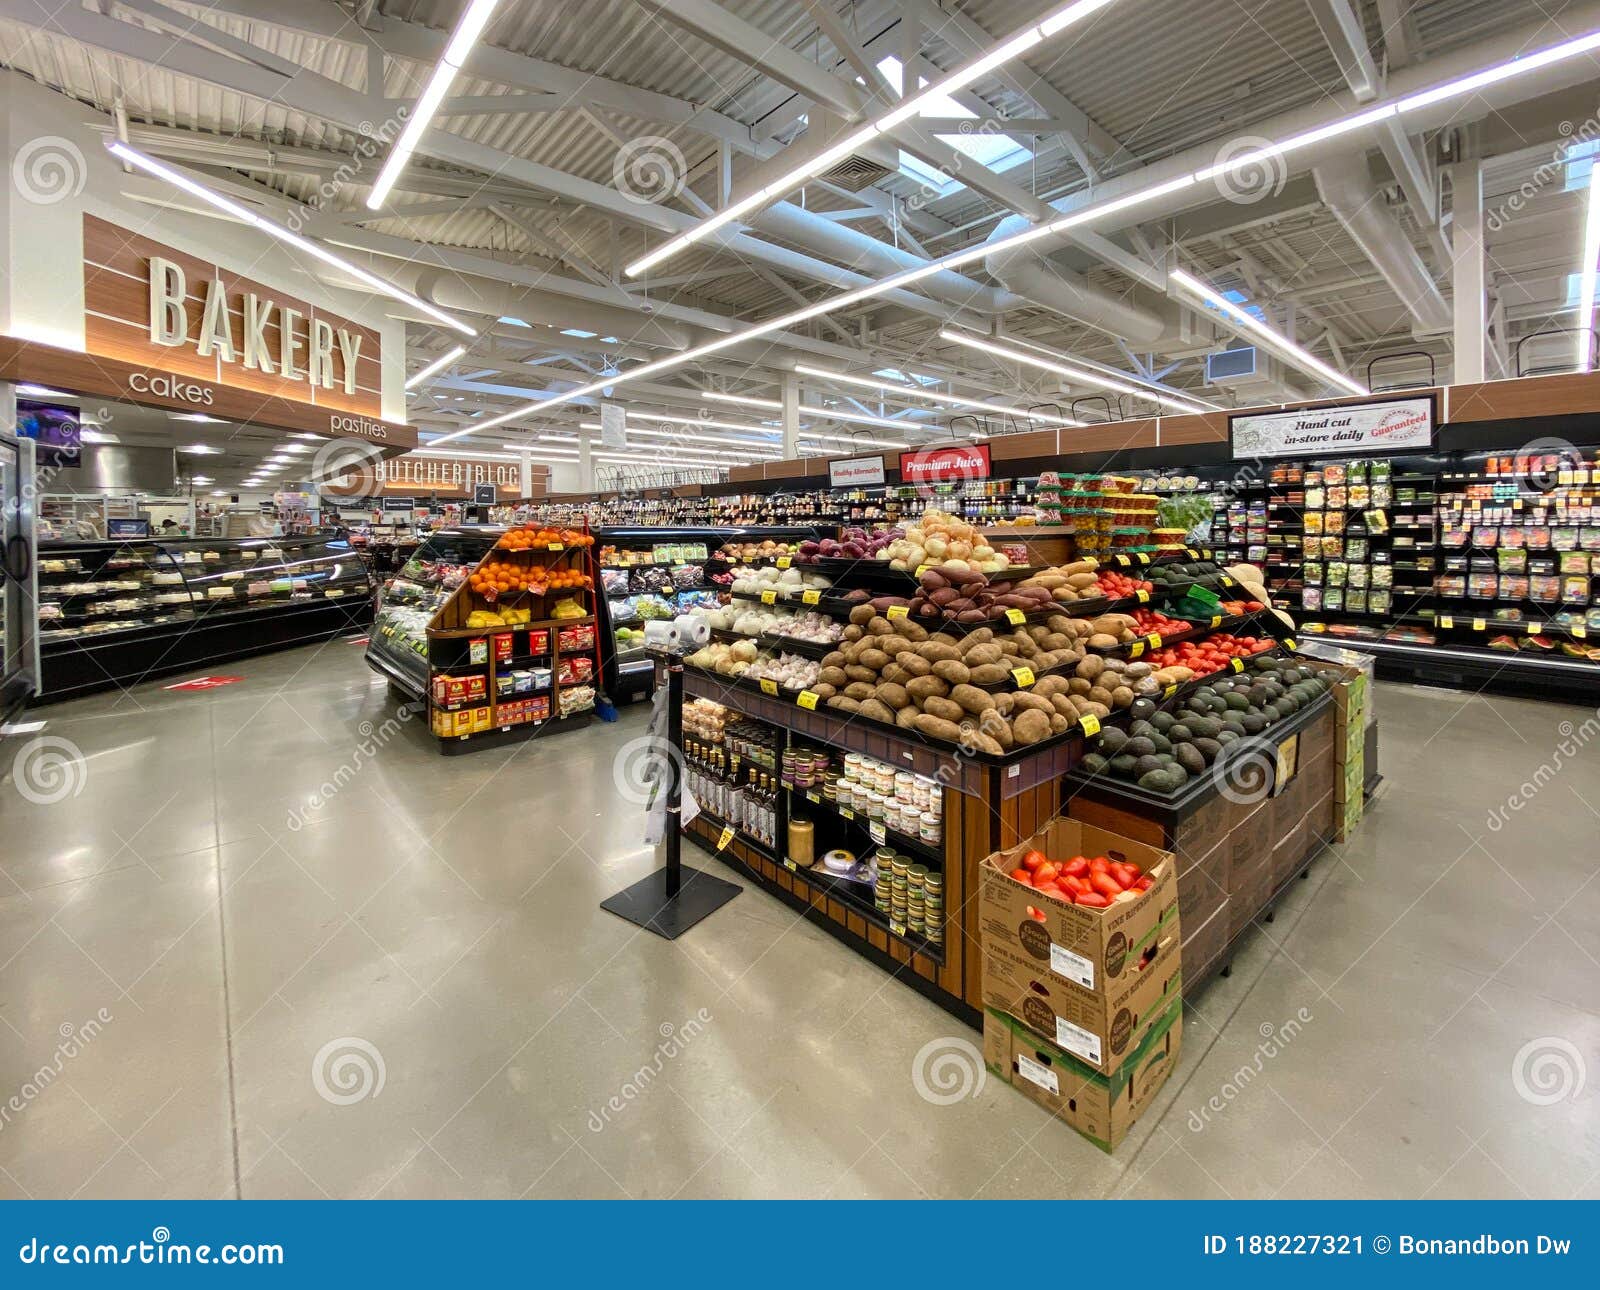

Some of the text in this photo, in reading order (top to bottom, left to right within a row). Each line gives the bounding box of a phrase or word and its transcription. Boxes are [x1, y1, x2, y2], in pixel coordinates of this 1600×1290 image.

[150, 257, 362, 394] BAKERY
[128, 373, 215, 405] cakes
[330, 415, 387, 438] pastries
[1295, 416, 1352, 431] Hand cut
[1370, 411, 1427, 438] Guaranteed
[1284, 429, 1364, 445] in-store daily
[375, 460, 518, 487] BUTCHER BLOC
[906, 456, 983, 473] Premium Juice
